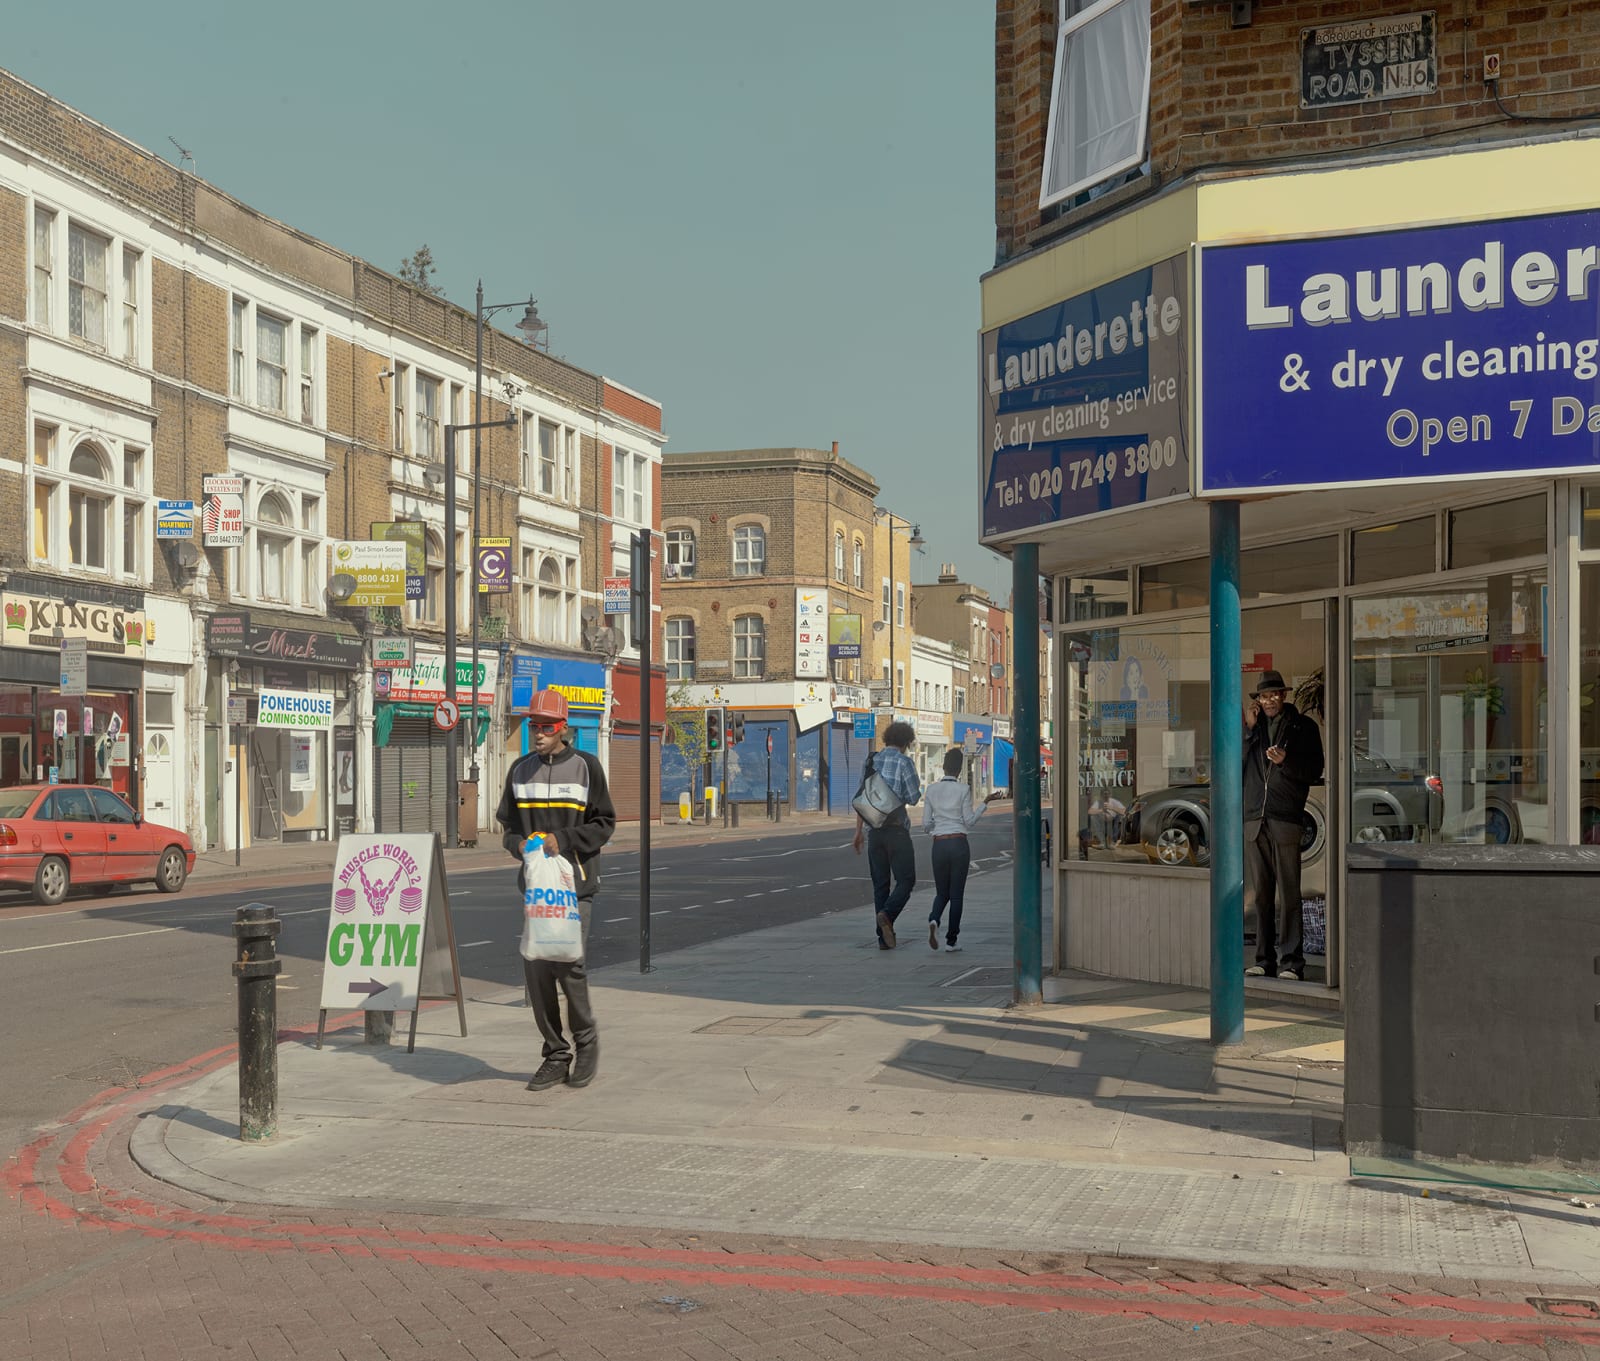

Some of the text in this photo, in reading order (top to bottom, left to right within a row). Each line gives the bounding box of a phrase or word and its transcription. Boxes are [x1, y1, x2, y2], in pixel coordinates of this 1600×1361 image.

[1316, 22, 1420, 43] BOROUGH OF HACKNEY
[1324, 37, 1416, 70] TYSSEN
[1310, 69, 1375, 100] ROAD
[988, 294, 1180, 396] Launderette
[1280, 331, 1599, 397] & dry cleaning
[993, 375, 1177, 452] & dry cleaning service
[1386, 408, 1492, 456] Open
[1509, 399, 1534, 440] 7
[995, 436, 1177, 508] Tel: 020 7249 3800
[223, 509, 241, 518] SHOP
[159, 520, 193, 528] SMARTMOVE
[221, 521, 242, 531] TO LET
[354, 545, 367, 553] Paul
[367, 545, 384, 553] Simon
[358, 574, 377, 582] 8800
[381, 574, 399, 582] 4321
[355, 596, 385, 604] TO LET
[30, 599, 125, 643] KINGS
[1451, 614, 1489, 634] WASHES
[252, 630, 317, 660] Musk
[315, 653, 347, 662] collection
[261, 694, 331, 714] FONEHOUSE
[260, 711, 331, 726] COMING SOON!!!
[1079, 749, 1118, 766] SHIRT
[1079, 770, 1136, 787] SERVICE
[338, 843, 422, 885] MUSCLE WORKS 2
[329, 922, 421, 967] GYM
